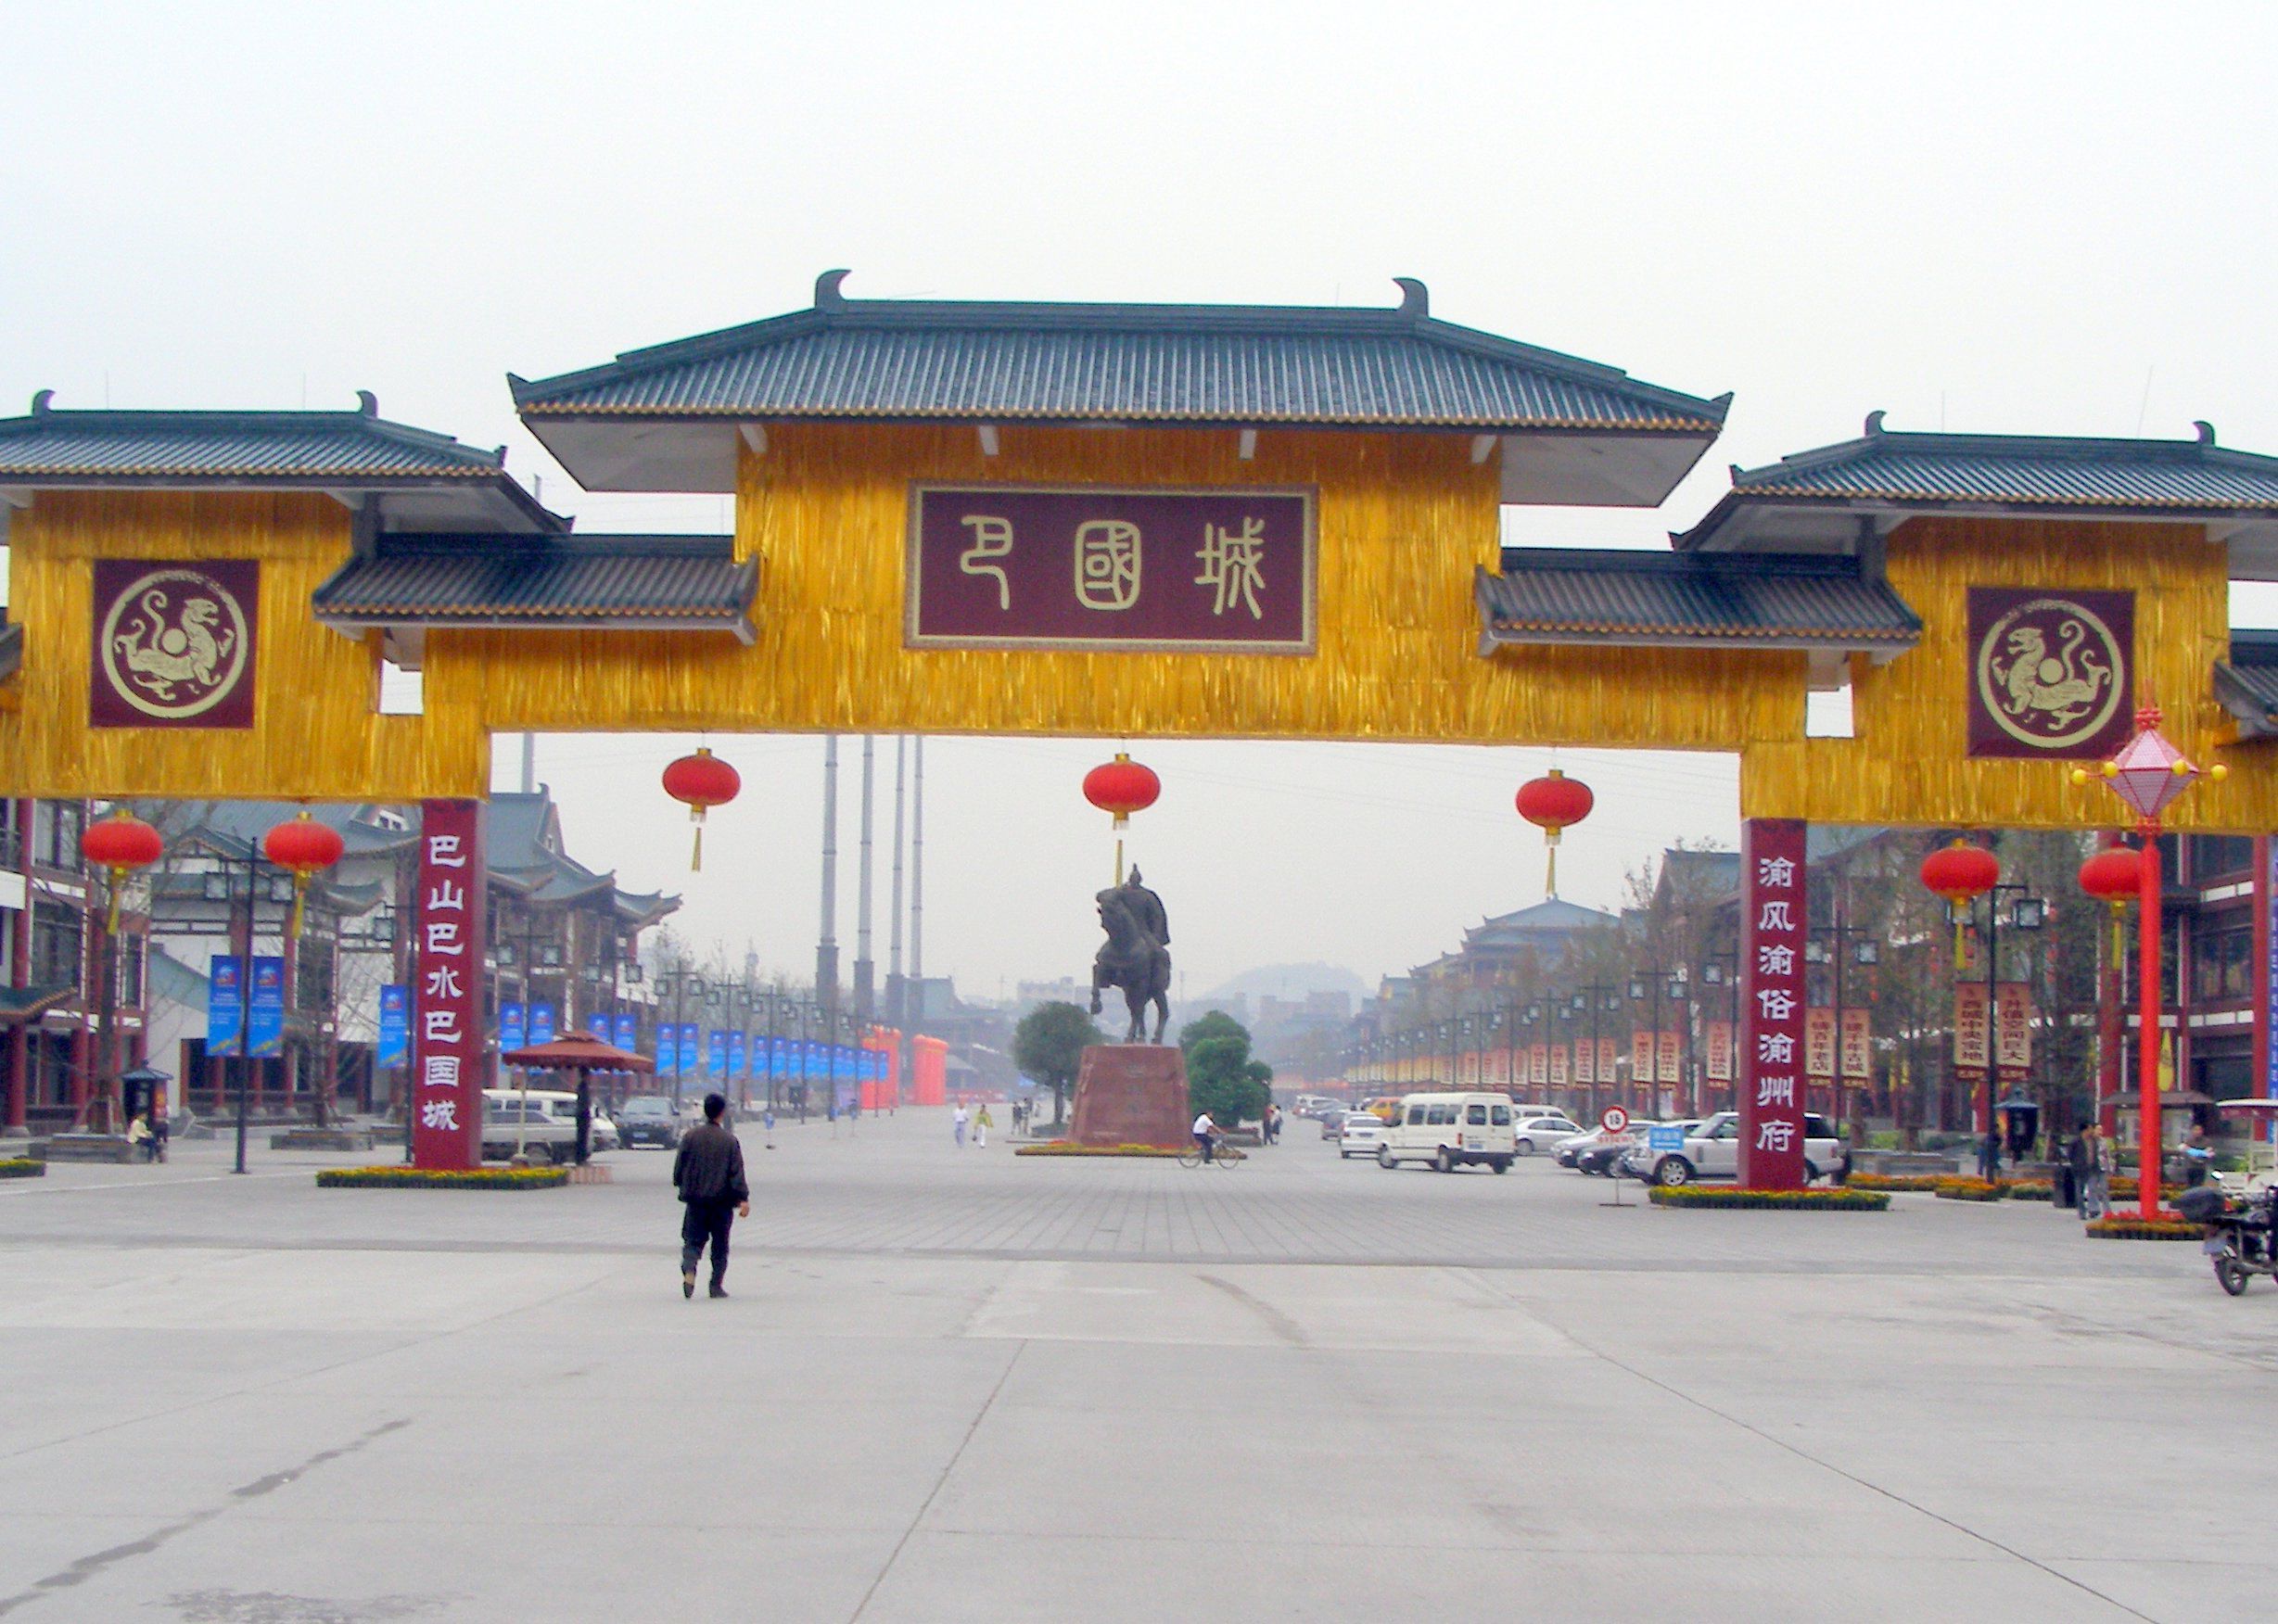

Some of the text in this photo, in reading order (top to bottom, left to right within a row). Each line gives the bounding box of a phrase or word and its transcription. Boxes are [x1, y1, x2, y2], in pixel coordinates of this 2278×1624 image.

[960, 514, 1266, 620] 巴國城
[422, 834, 466, 1132] 巴山巴水巴国城
[1756, 856, 1797, 1153] 渝风渝俗渝州府
[1609, 1114, 1621, 1125] 15
